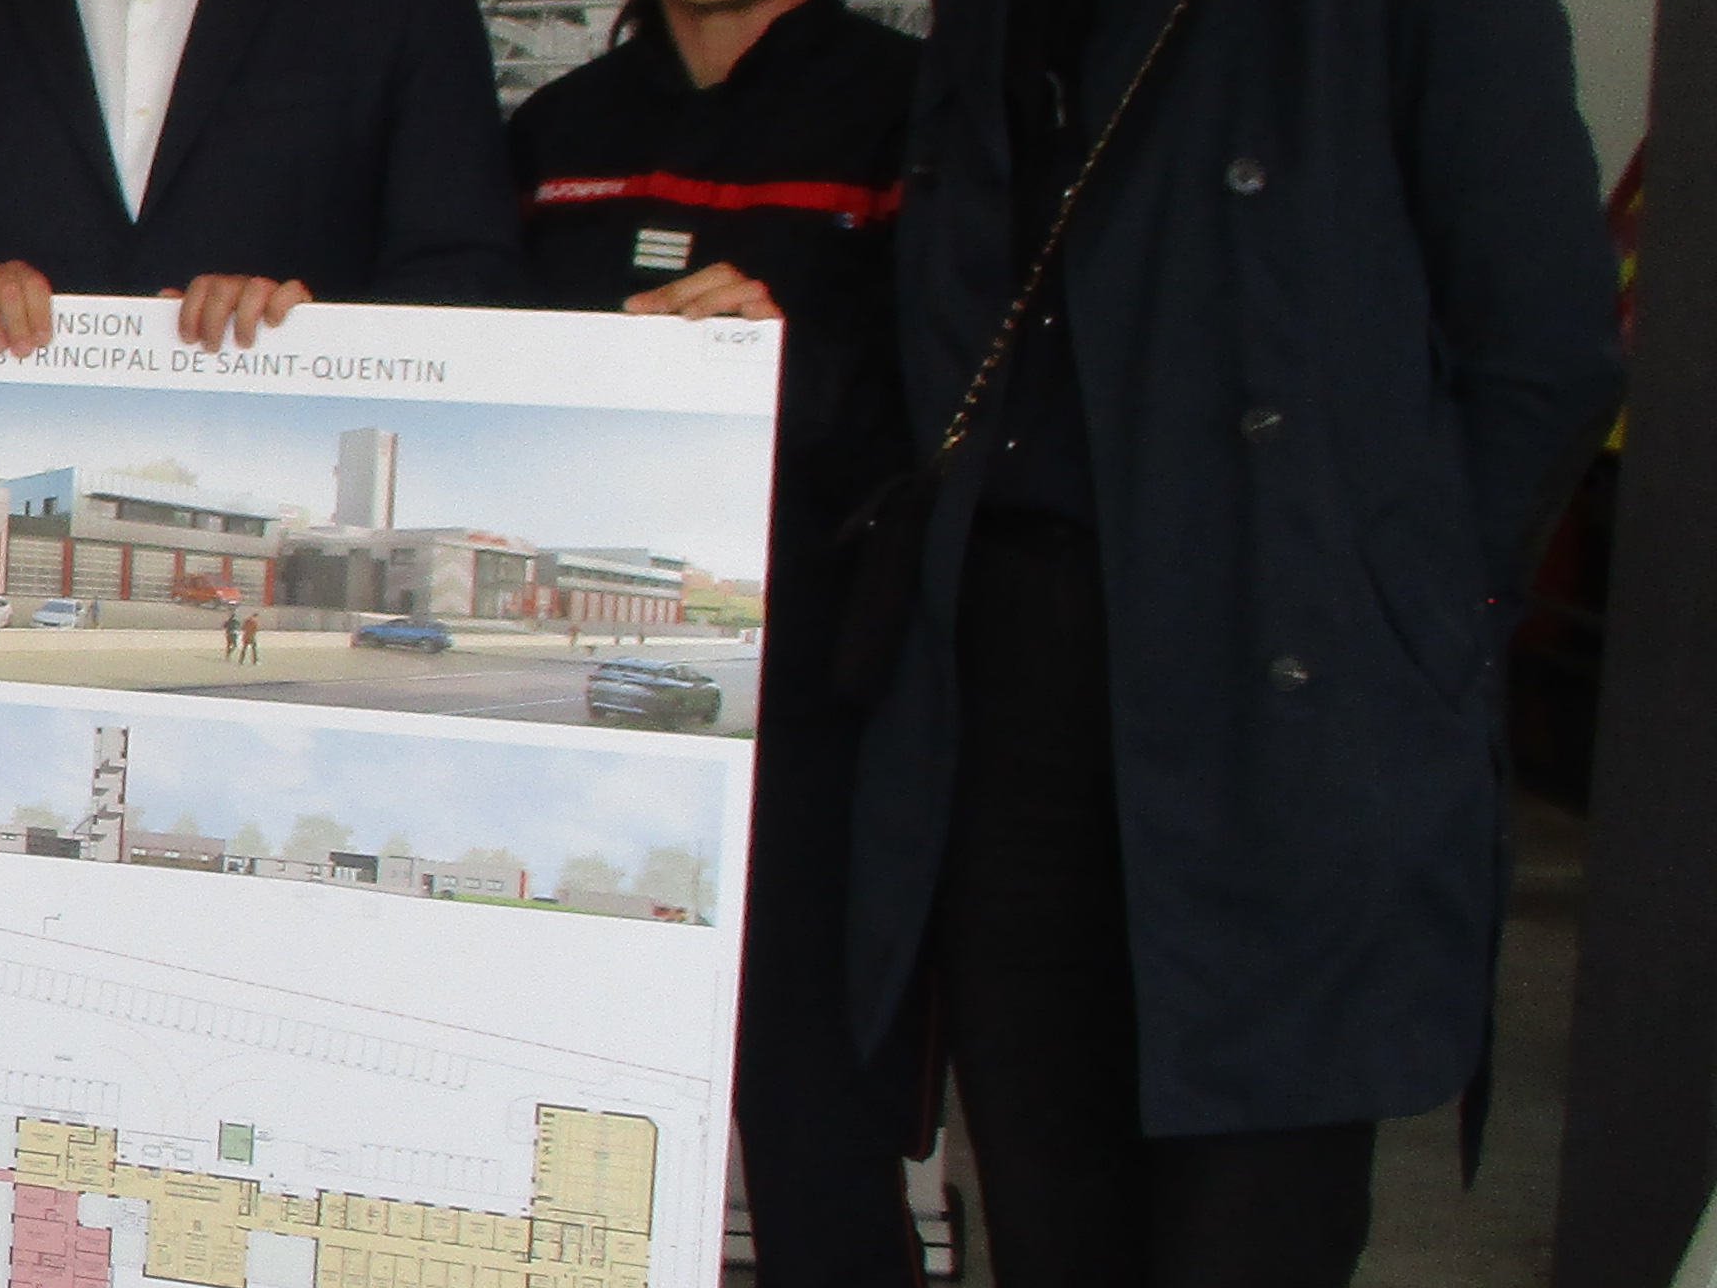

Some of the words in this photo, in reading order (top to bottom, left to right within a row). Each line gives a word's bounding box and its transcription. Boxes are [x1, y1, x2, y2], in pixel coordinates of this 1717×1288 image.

[56, 313, 142, 336] NSION
[19, 345, 160, 371] RINCIPAL
[171, 350, 204, 373] DE
[216, 352, 446, 382] SAINT-QUENTIN
